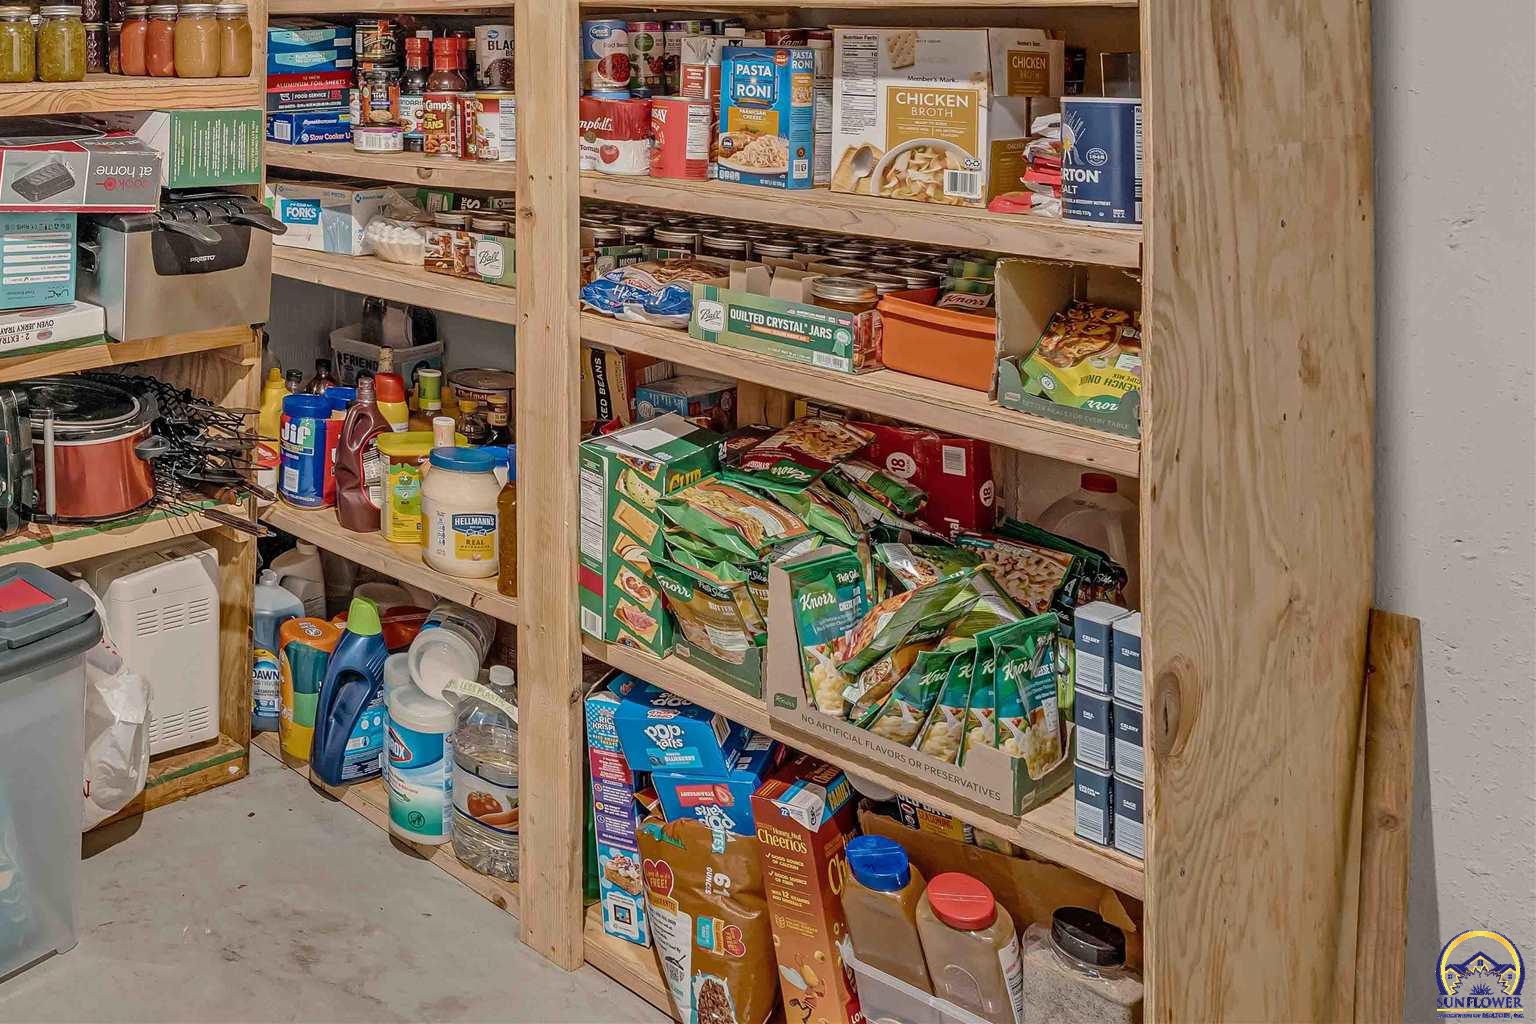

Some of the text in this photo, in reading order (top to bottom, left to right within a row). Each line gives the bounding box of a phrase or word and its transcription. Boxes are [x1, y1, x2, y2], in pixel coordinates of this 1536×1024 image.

[736, 64, 772, 77] PASTA
[736, 84, 771, 99] RONI
[895, 92, 969, 108] CHICKEN
[911, 107, 953, 118] BROTH
[96, 165, 153, 177] at home
[1062, 167, 1100, 184] RTON
[286, 206, 317, 219] FORKS
[190, 254, 215, 264] PRESTO
[479, 250, 499, 264] Ball
[941, 292, 992, 309] Knorr
[699, 307, 723, 323] Ball
[16, 322, 37, 332] JERKY
[37, 319, 54, 329] OVEN
[730, 308, 833, 340] QUILTED CRYSTAL JARS
[594, 356, 608, 391] BEANS
[1085, 398, 1121, 413] norr
[281, 421, 311, 445] Jif
[891, 458, 906, 473] 18
[455, 515, 496, 526] HELLMANN'S
[799, 589, 836, 611] Knorr
[252, 669, 279, 681] DAWN
[1002, 657, 1035, 682] Knorr
[801, 712, 1002, 801] NO ARTIFICIAL FLAVORS OR PRESERVATIVES
[757, 828, 809, 855] Cheerios
